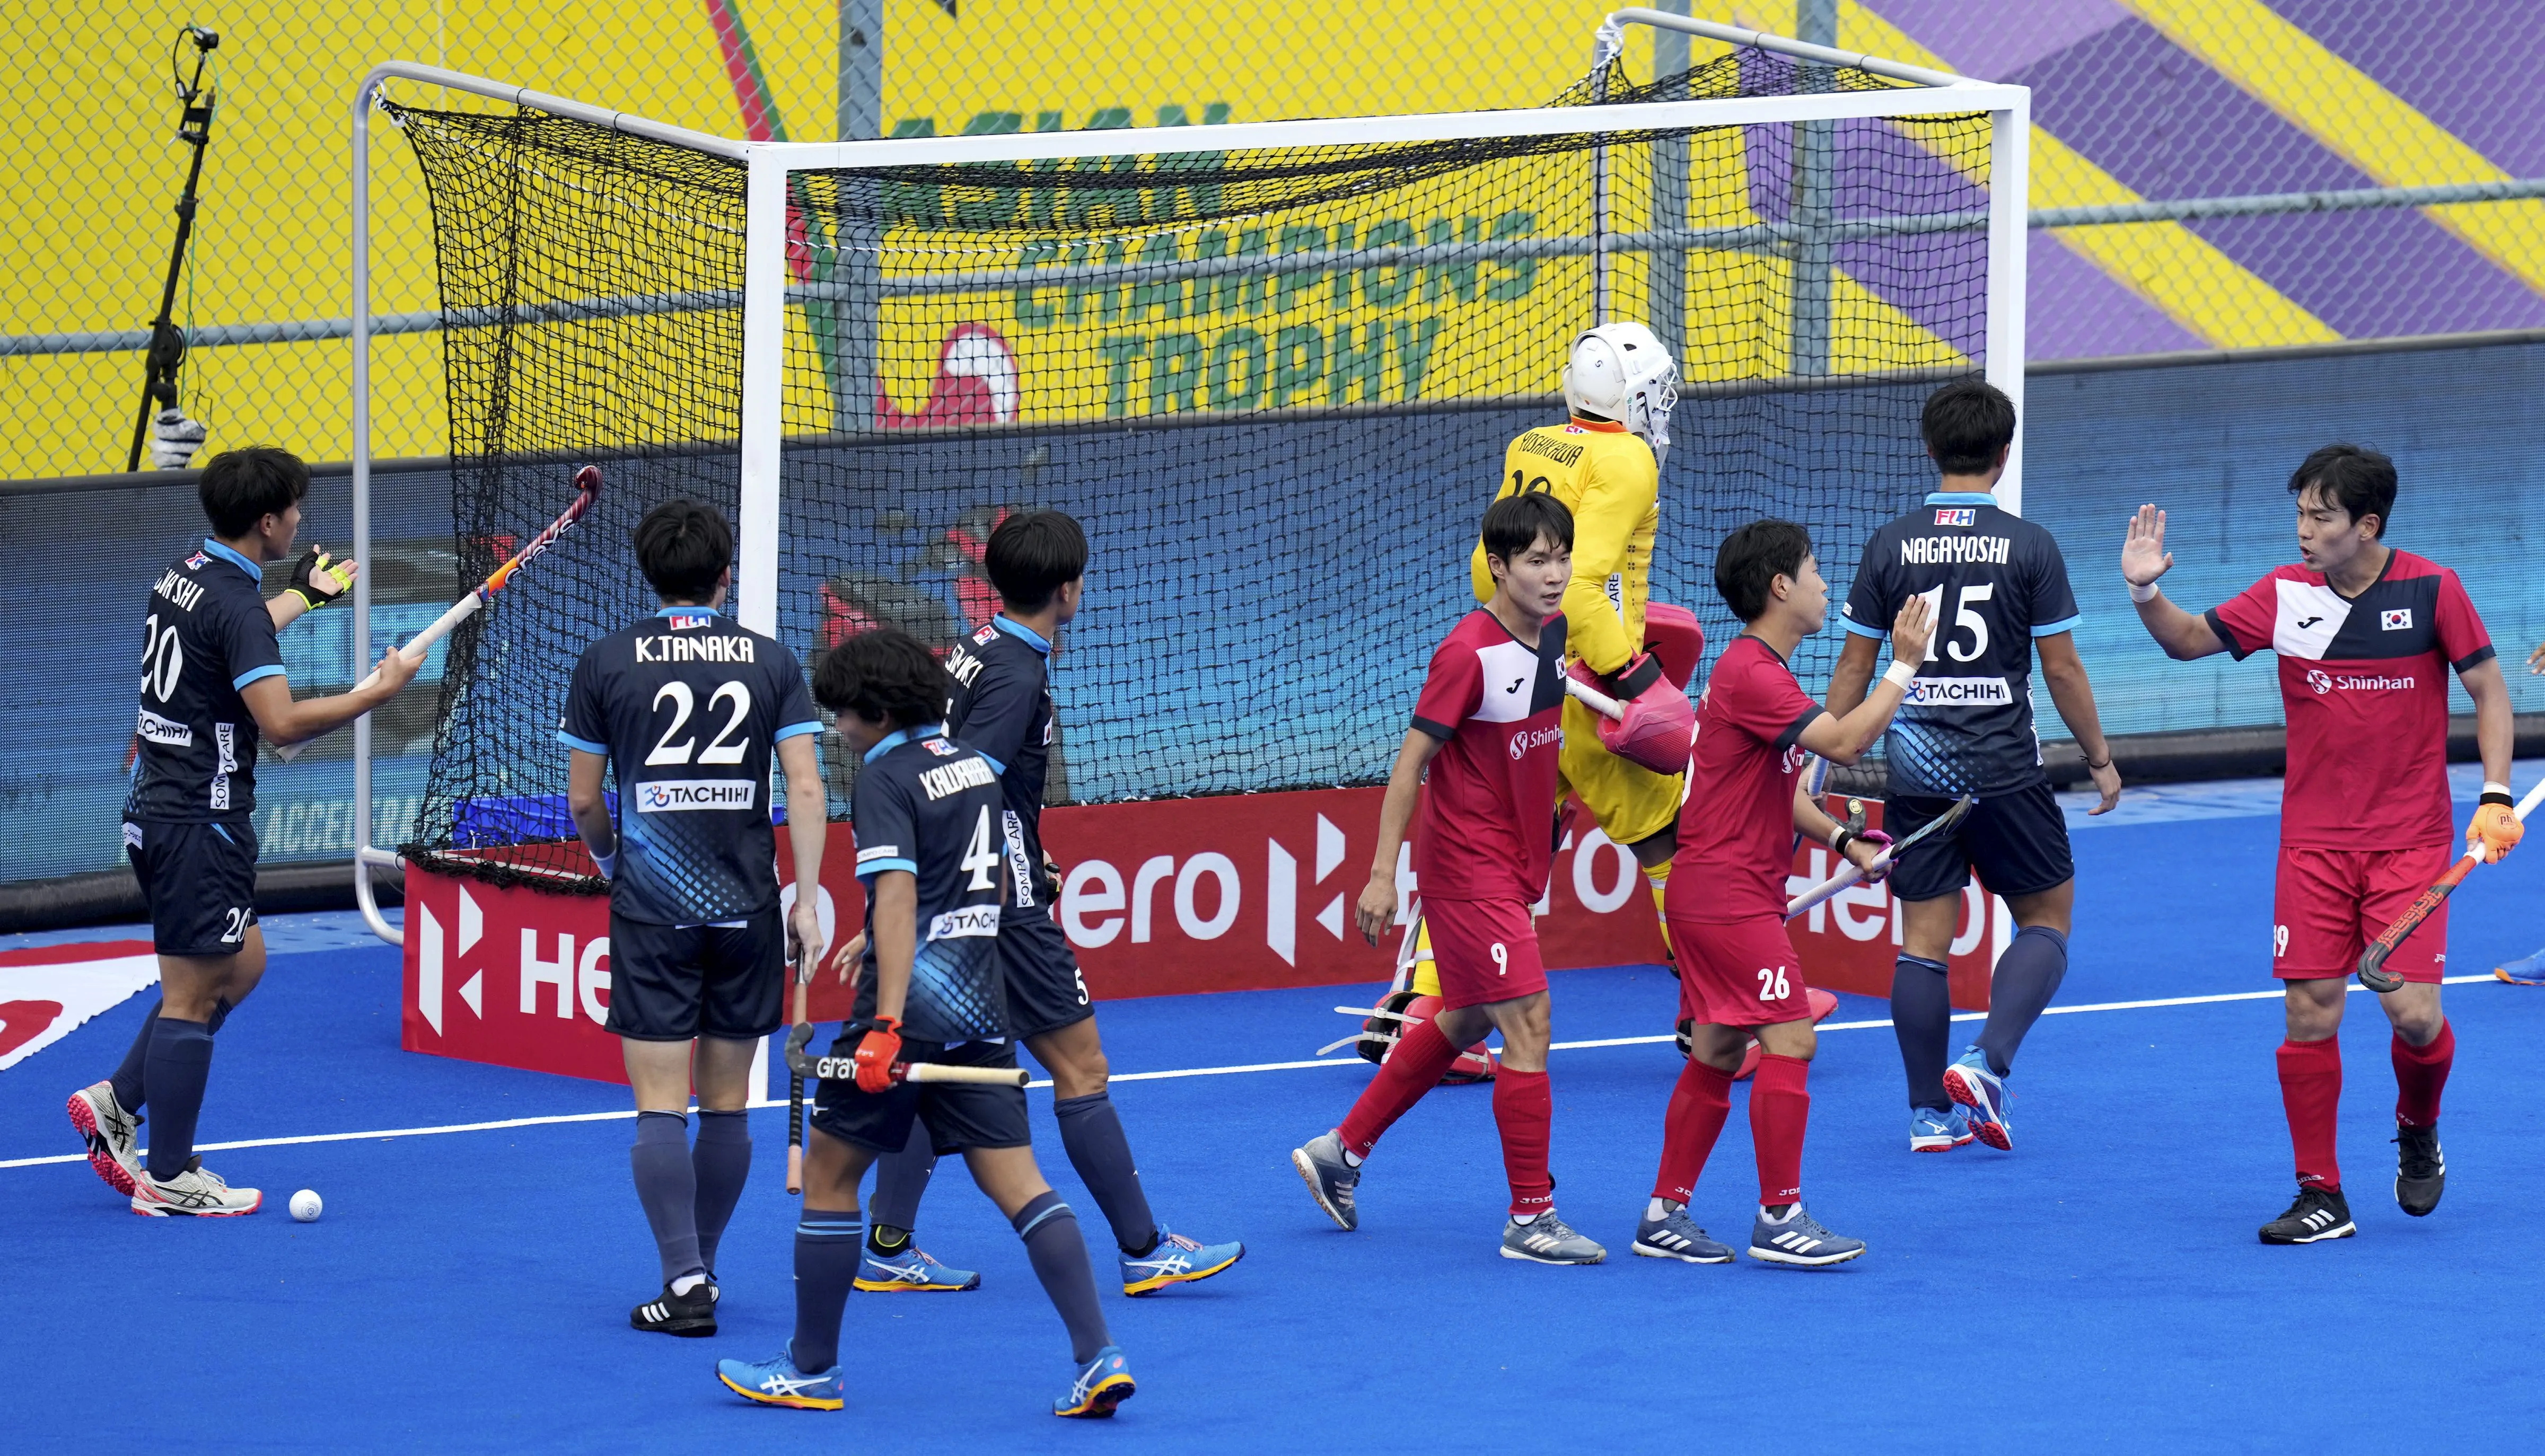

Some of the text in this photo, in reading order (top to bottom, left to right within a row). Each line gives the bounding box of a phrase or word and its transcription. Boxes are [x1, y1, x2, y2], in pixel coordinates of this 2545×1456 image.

[1015, 212, 1537, 327] CHAMPIONS
[1099, 317, 1441, 416] TROPHY
[1519, 431, 1584, 468] YOSHIKAWA
[1901, 536, 2010, 566] NAGAYOSHI
[1918, 582, 1994, 661] 15
[140, 614, 183, 703] 20
[636, 635, 754, 663] K.TANAKA
[1925, 684, 2006, 699] TACHIHI
[2337, 675, 2415, 690] Shinhan
[644, 681, 751, 766] 22
[1530, 724, 1560, 748] Shinh
[216, 724, 235, 808] SOMO CARE
[670, 787, 749, 803] TACHIHI
[960, 804, 999, 891] 4
[1006, 811, 1032, 905] SOMPO CARE
[1049, 852, 1241, 949] ero
[221, 907, 251, 943] 20
[955, 912, 996, 930] TACH
[1490, 942, 1507, 975] 9
[1074, 967, 1089, 1005] 5
[1758, 966, 1790, 1001] 26
[817, 1056, 859, 1079] Gray
